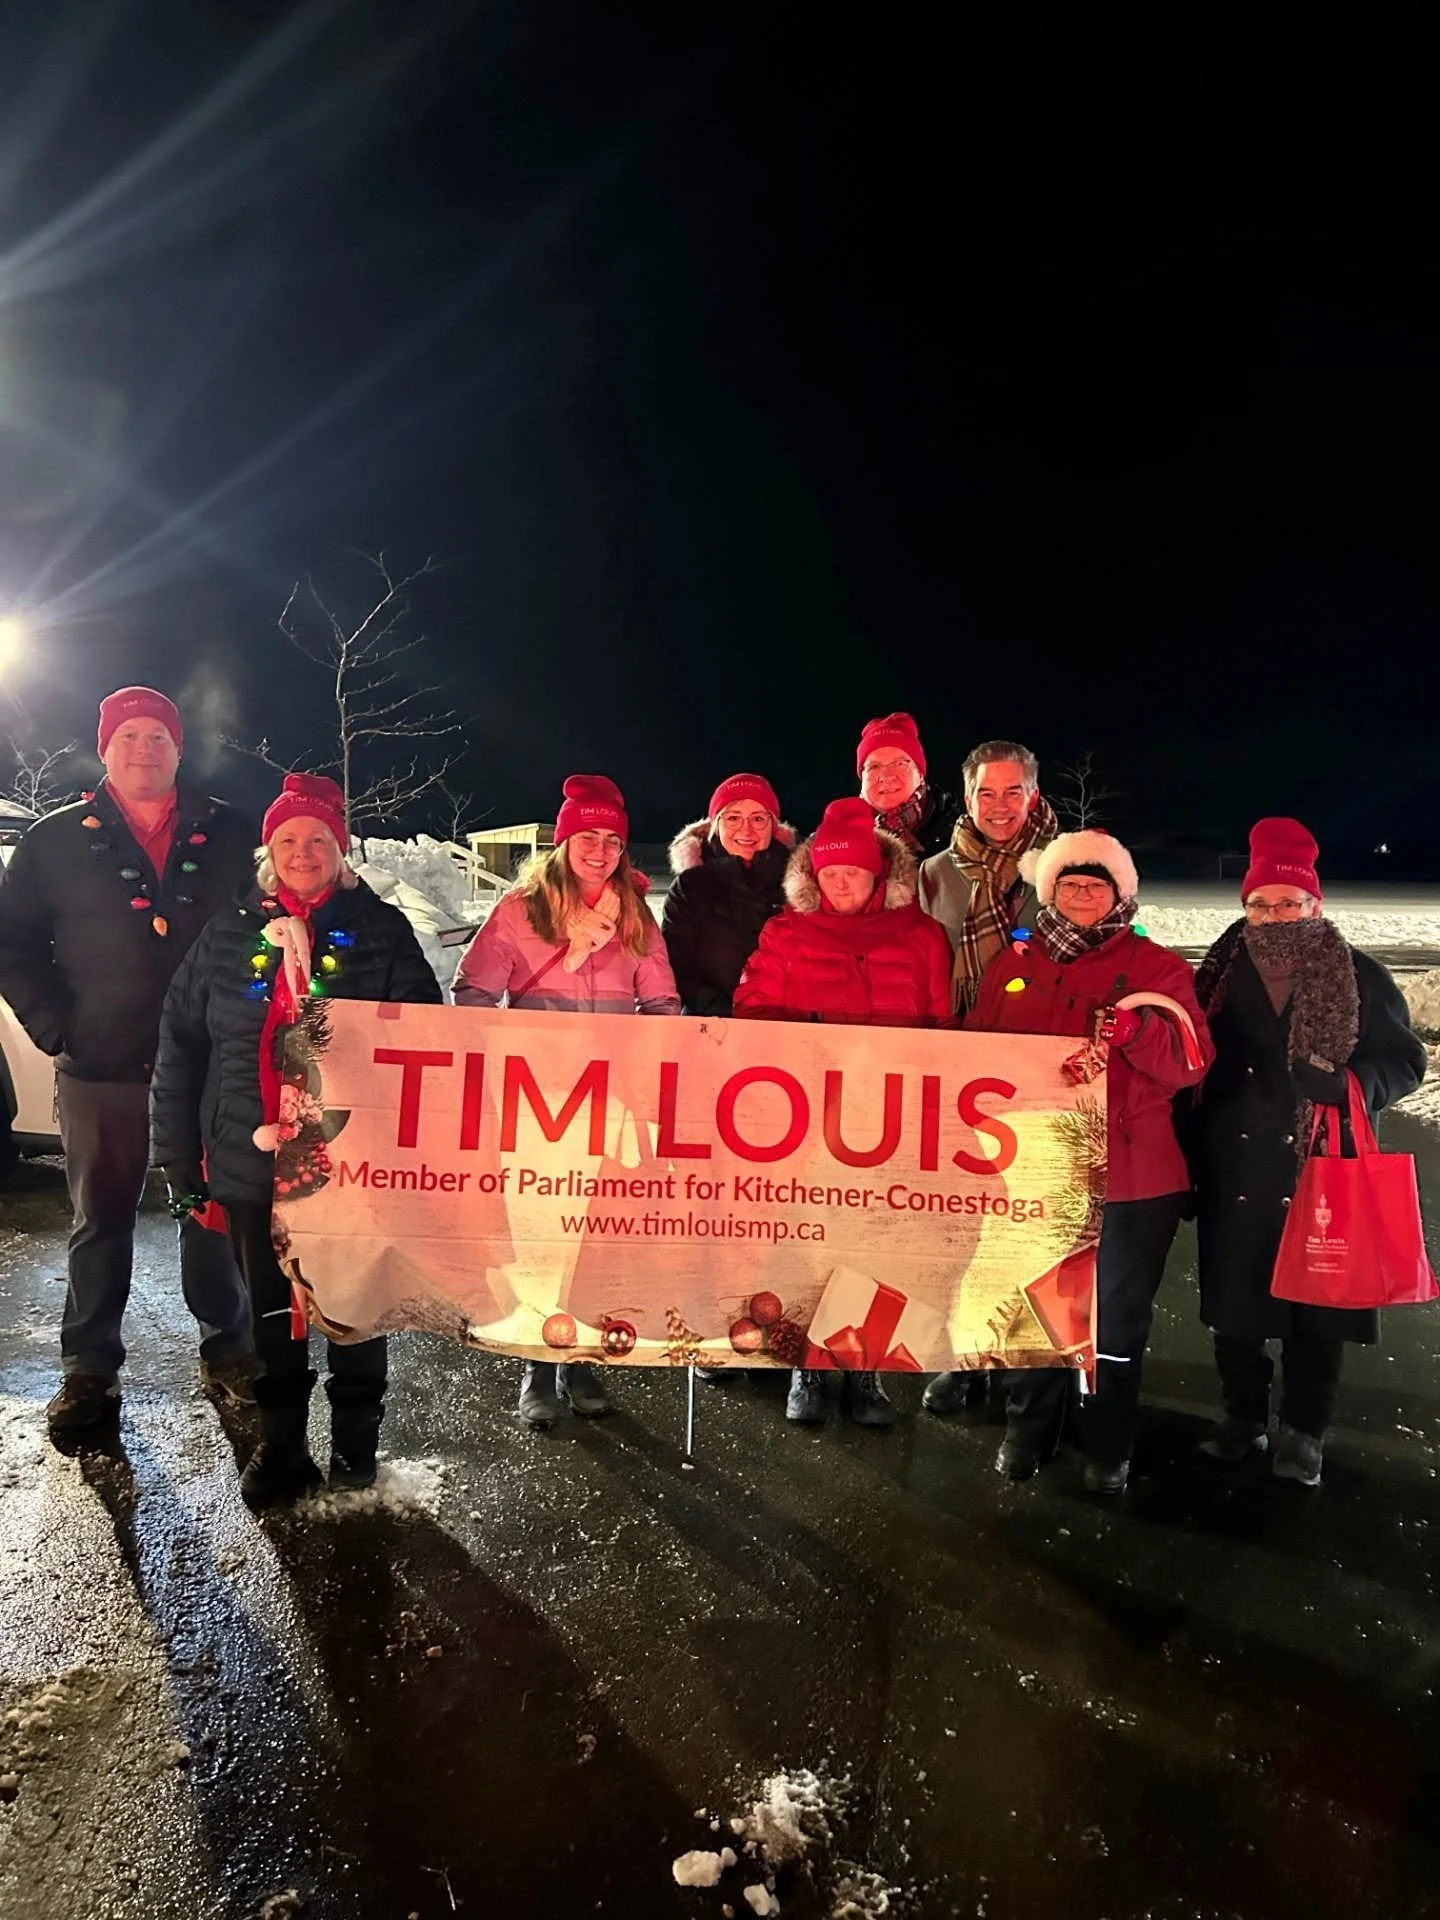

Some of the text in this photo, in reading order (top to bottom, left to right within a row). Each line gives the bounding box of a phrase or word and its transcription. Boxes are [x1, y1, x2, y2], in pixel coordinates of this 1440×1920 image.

[580, 808, 595, 816] TIM
[825, 842, 849, 850] LOUIS
[1275, 864, 1293, 872] TIM
[374, 1047, 1018, 1176] TIM LOUIS
[338, 1160, 1044, 1222] Member of Parliament for Kitchener-Conestoga
[561, 1213, 825, 1244] www.timlouismp.ca
